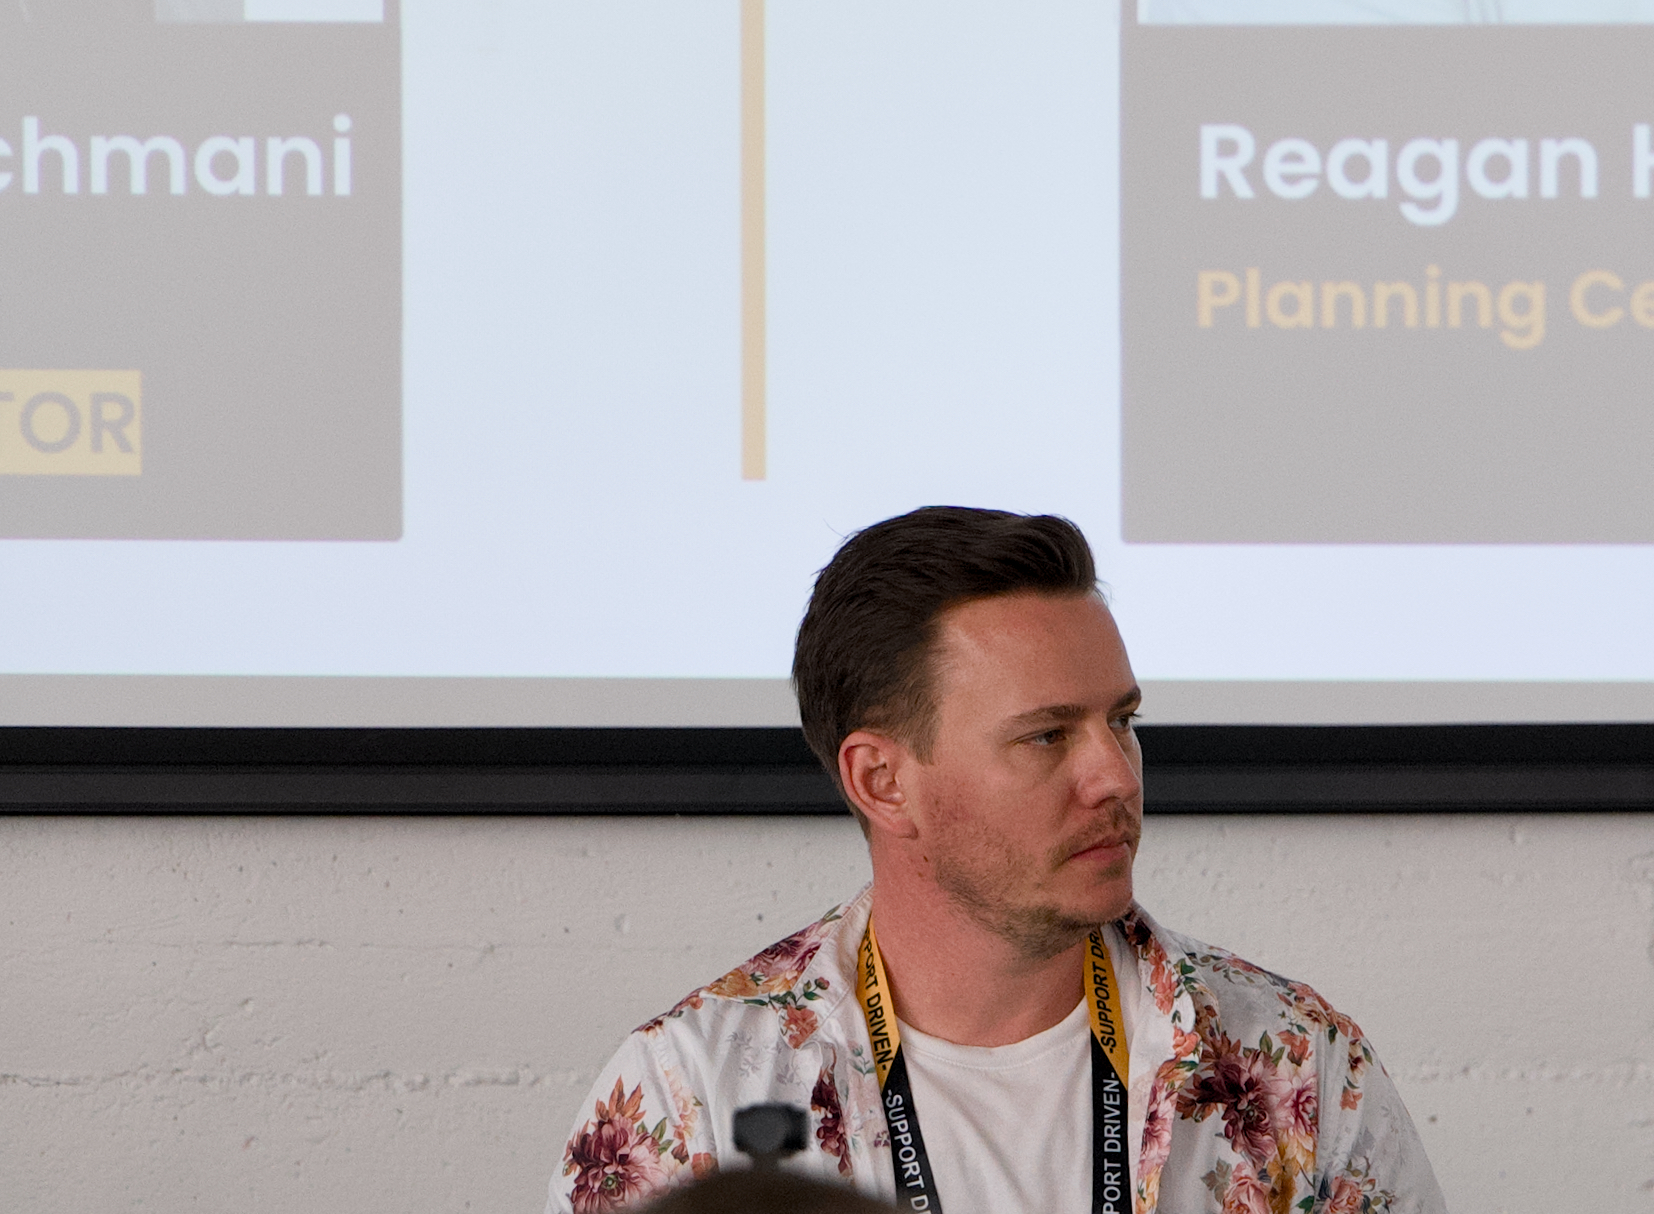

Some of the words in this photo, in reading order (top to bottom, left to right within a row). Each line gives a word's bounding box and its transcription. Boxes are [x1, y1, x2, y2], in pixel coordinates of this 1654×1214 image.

[1199, 122, 1599, 226] Reagan
[1195, 264, 1547, 350] Planning
[866, 992, 894, 1071] DRIVEN-
[1091, 961, 1117, 1054] -SUPPORT
[885, 1089, 925, 1189] -SUPPORT
[1102, 1071, 1122, 1153] DRIVEN-
